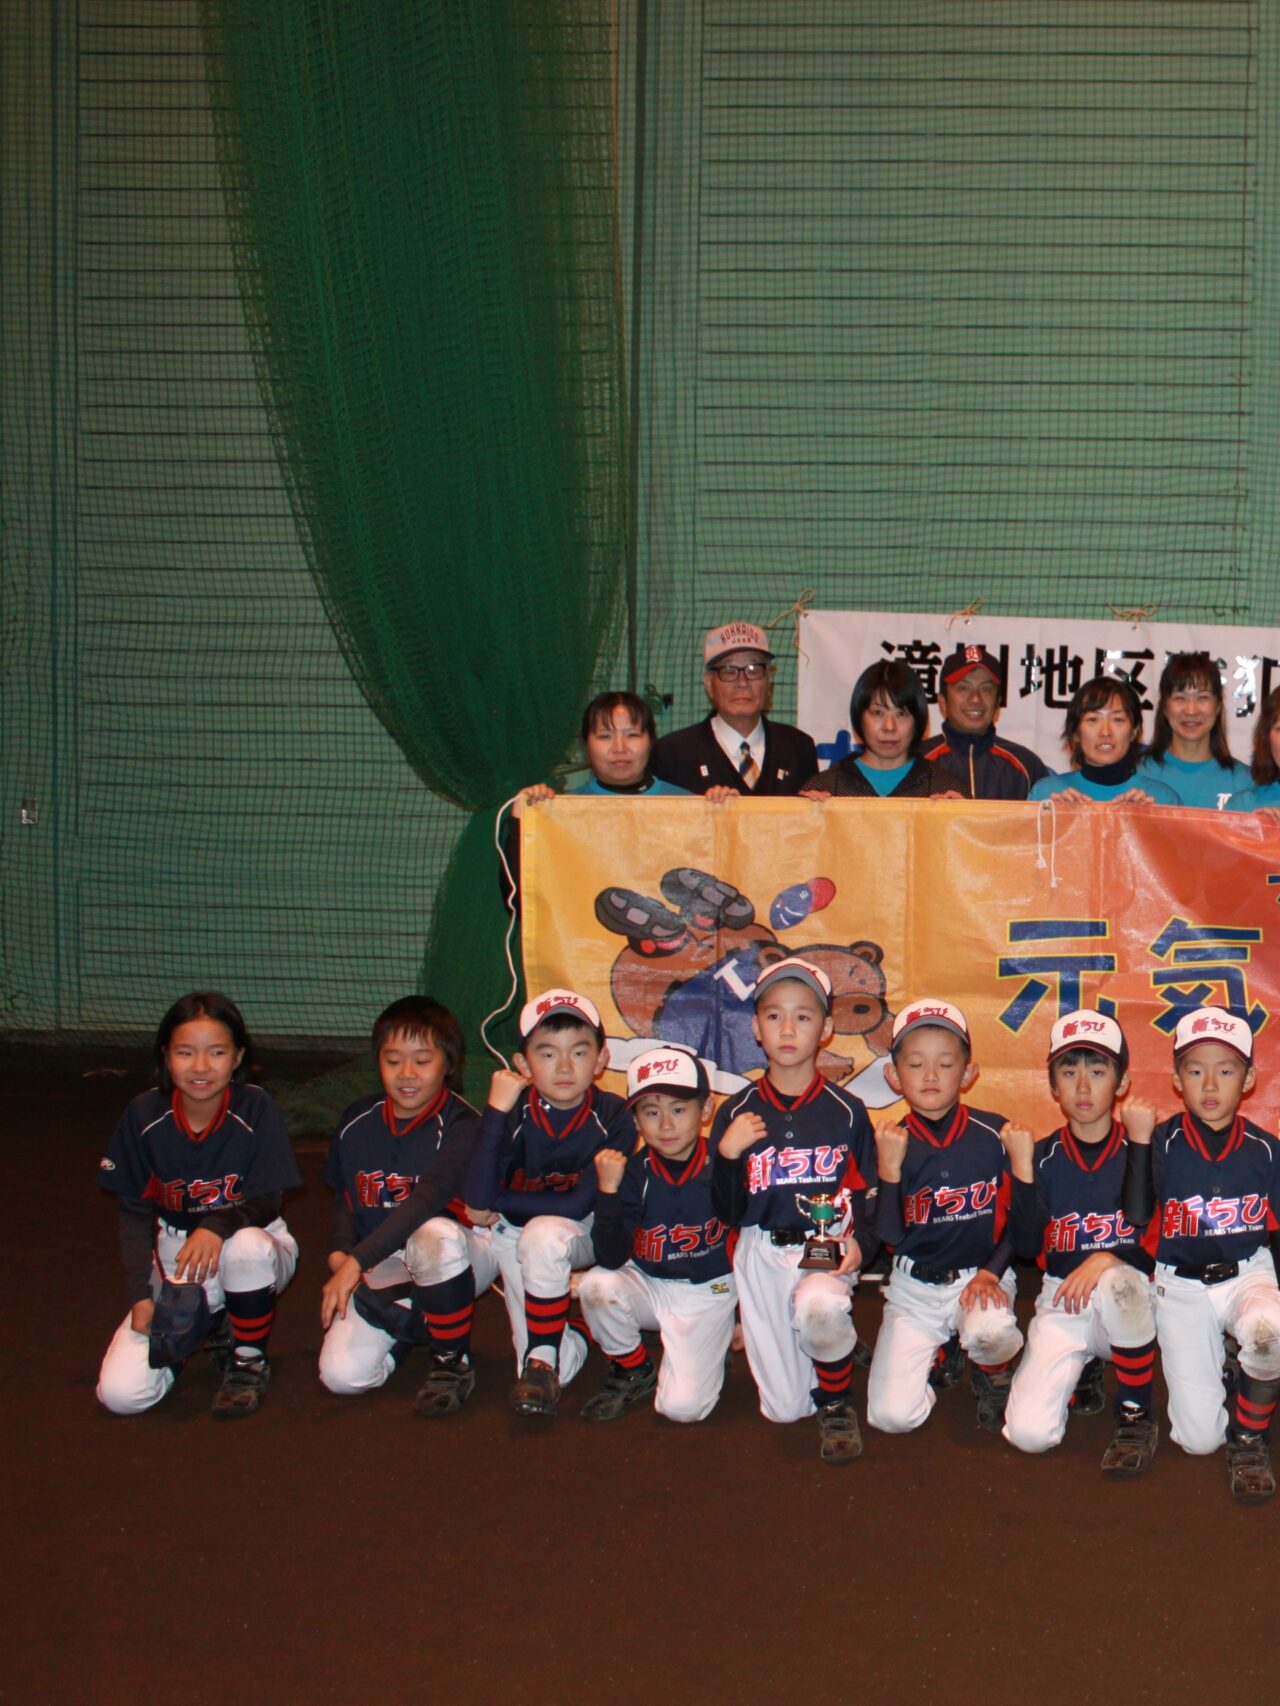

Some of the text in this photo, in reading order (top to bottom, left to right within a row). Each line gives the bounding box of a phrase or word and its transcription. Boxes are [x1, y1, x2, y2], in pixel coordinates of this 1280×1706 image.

[1063, 1020, 1106, 1039] 新ちび
[1192, 1016, 1236, 1034] 新ちび
[637, 1058, 679, 1083] 新ちび
[746, 1144, 848, 1195] 新ちび
[904, 1176, 997, 1227] 新ちび
[1162, 1192, 1268, 1239] 新ちび
[633, 1217, 730, 1263] 新ちび
